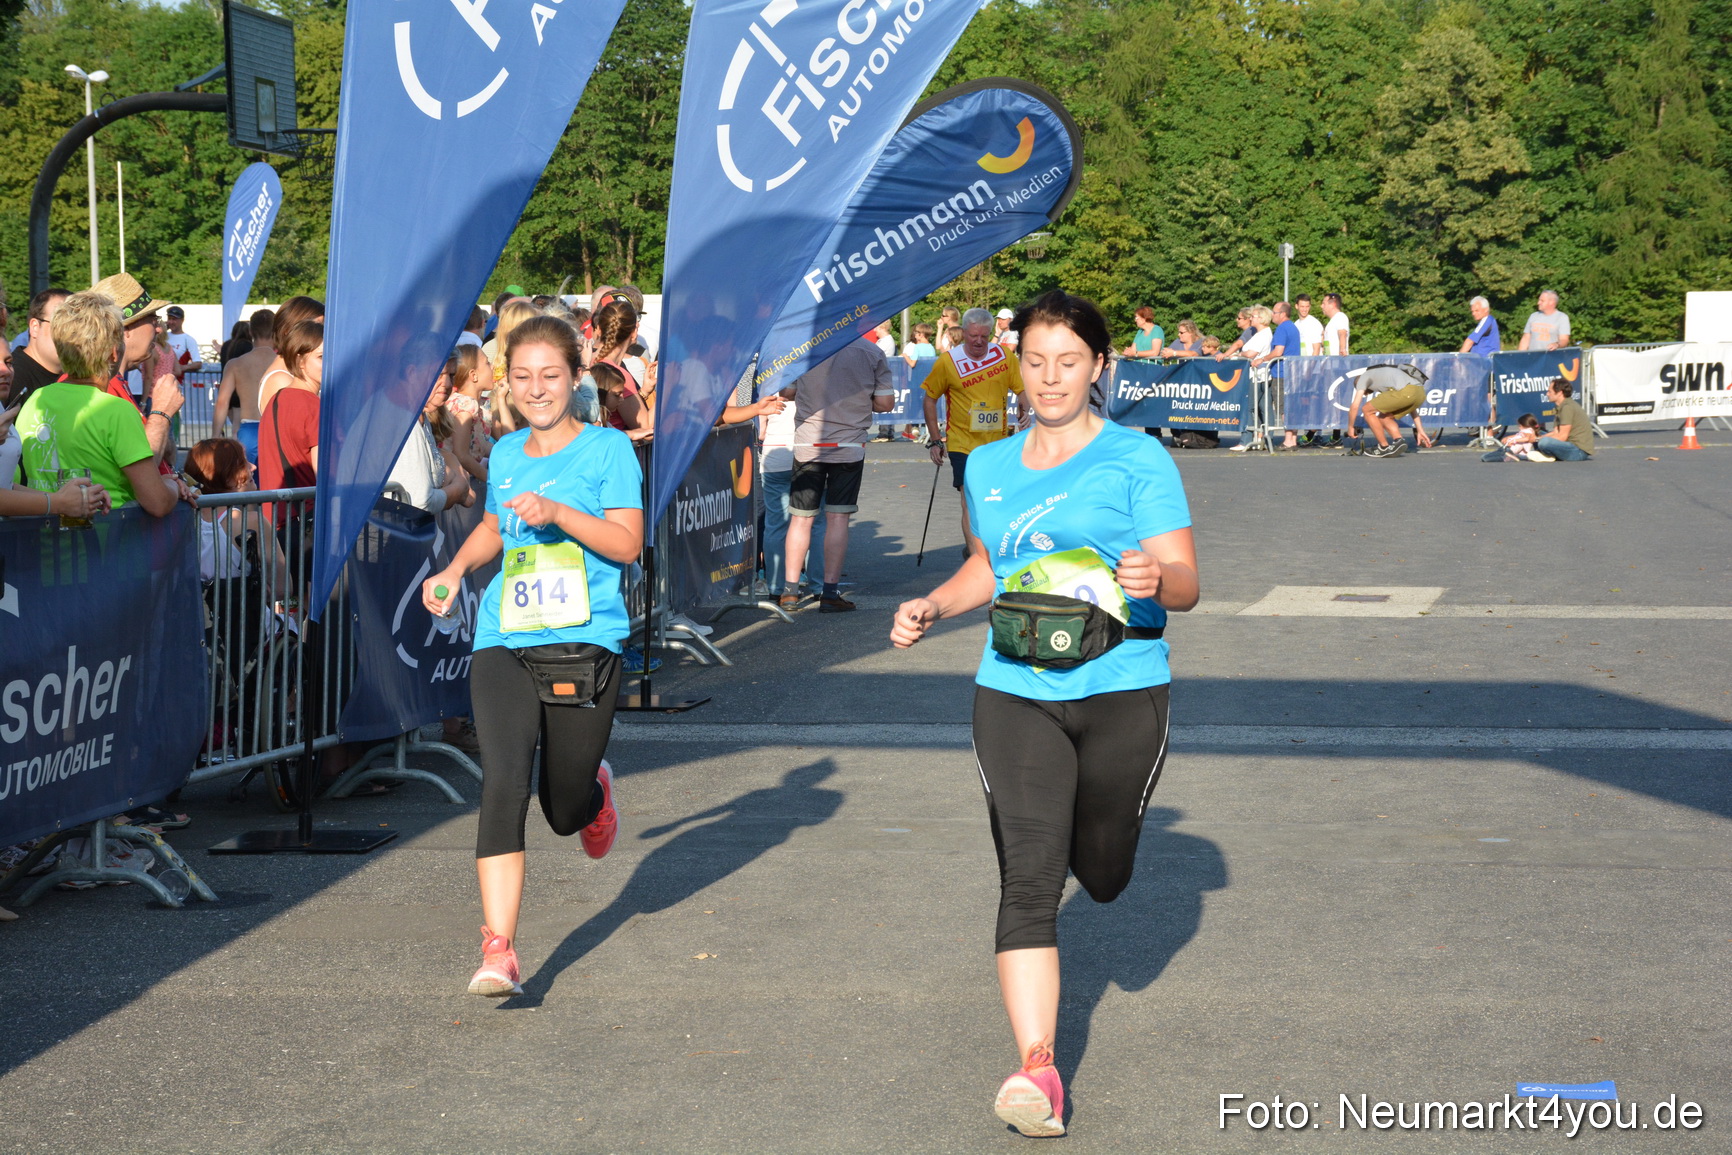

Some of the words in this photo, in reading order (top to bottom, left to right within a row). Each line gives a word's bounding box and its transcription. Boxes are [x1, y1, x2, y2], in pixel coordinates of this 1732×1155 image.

[761, 0, 893, 147] Fisc
[828, 0, 931, 144] AUTOMO
[236, 182, 269, 267] Fischer
[928, 218, 974, 252] Druck
[976, 201, 1005, 224] und
[1006, 166, 1062, 209] Medien
[803, 179, 996, 303] Frischmann
[962, 374, 985, 388] MAX
[1117, 379, 1212, 401] Frischmann
[1660, 362, 1724, 394] swn
[978, 413, 999, 424] 906
[1172, 400, 1193, 410] Druck
[1195, 401, 1209, 410] und
[1210, 401, 1241, 411] Medien
[997, 532, 1012, 557] Team
[1009, 504, 1044, 531] Schick
[1045, 491, 1068, 506] Bau
[514, 577, 569, 608] 814
